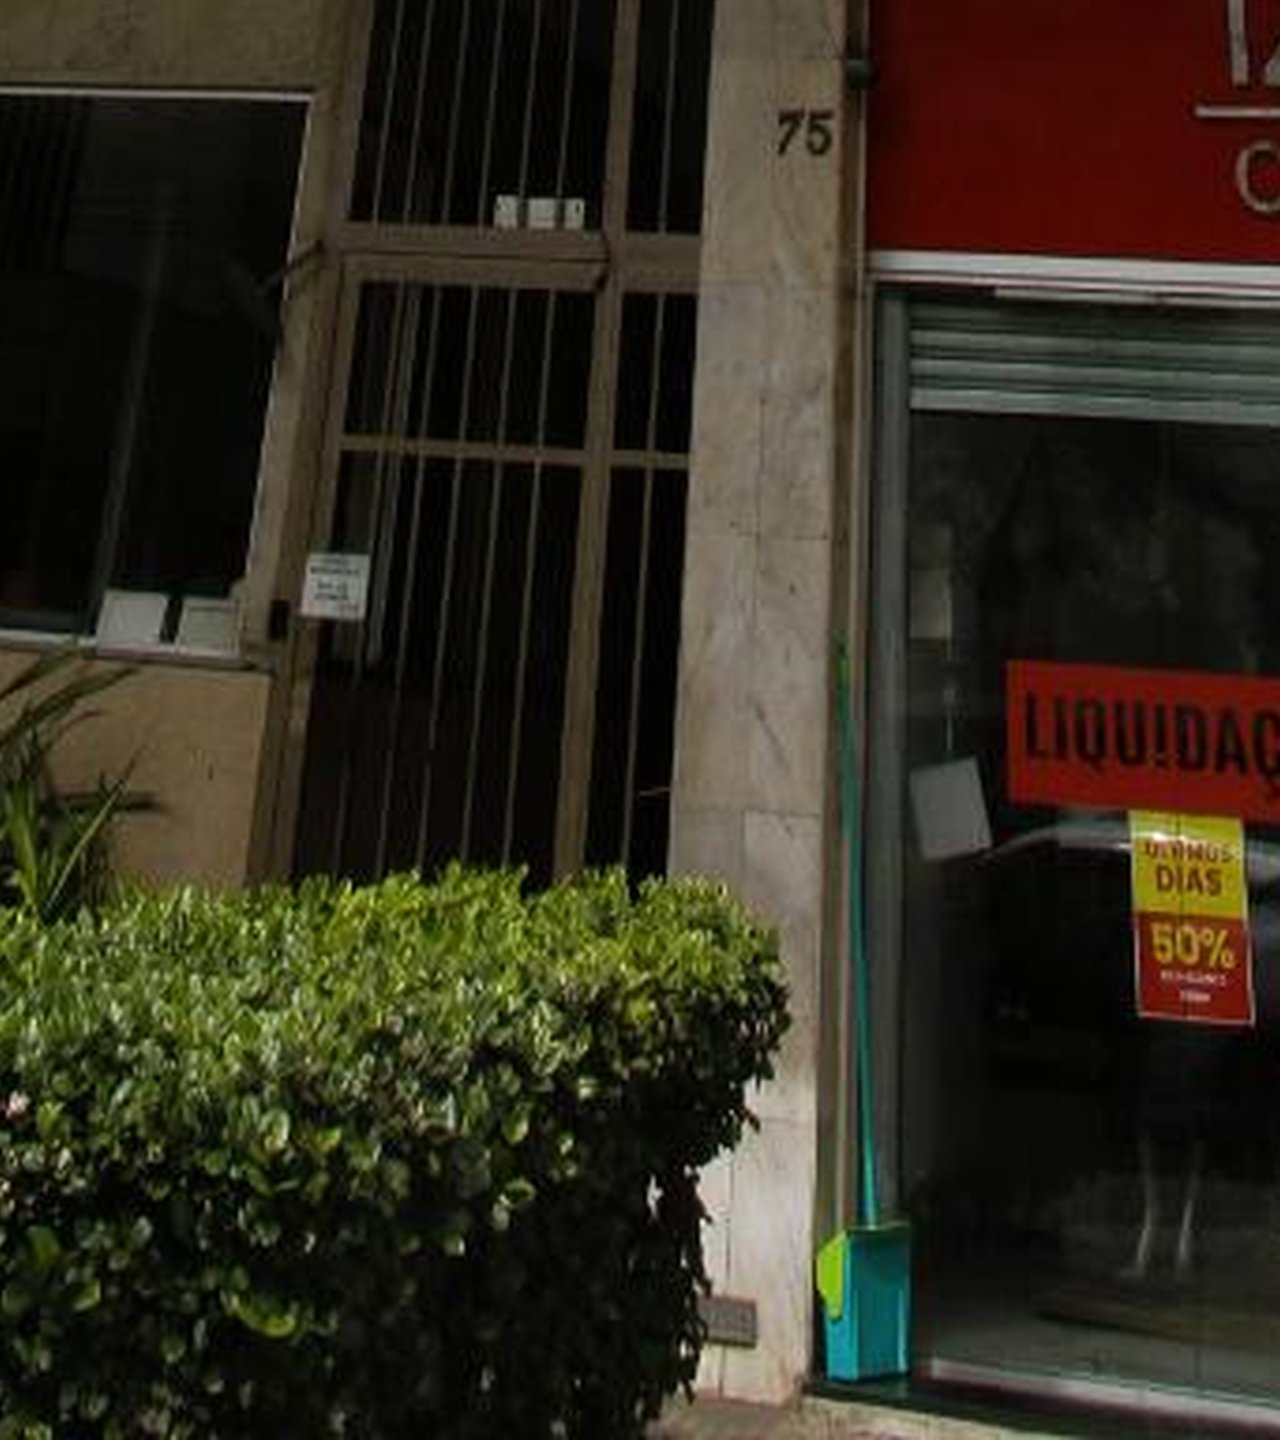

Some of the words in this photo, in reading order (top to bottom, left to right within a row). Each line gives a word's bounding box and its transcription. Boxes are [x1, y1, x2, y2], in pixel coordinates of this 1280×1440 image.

[778, 108, 834, 156] 75
[1155, 865, 1223, 896] DIAS
[1150, 921, 1237, 968] 50%
